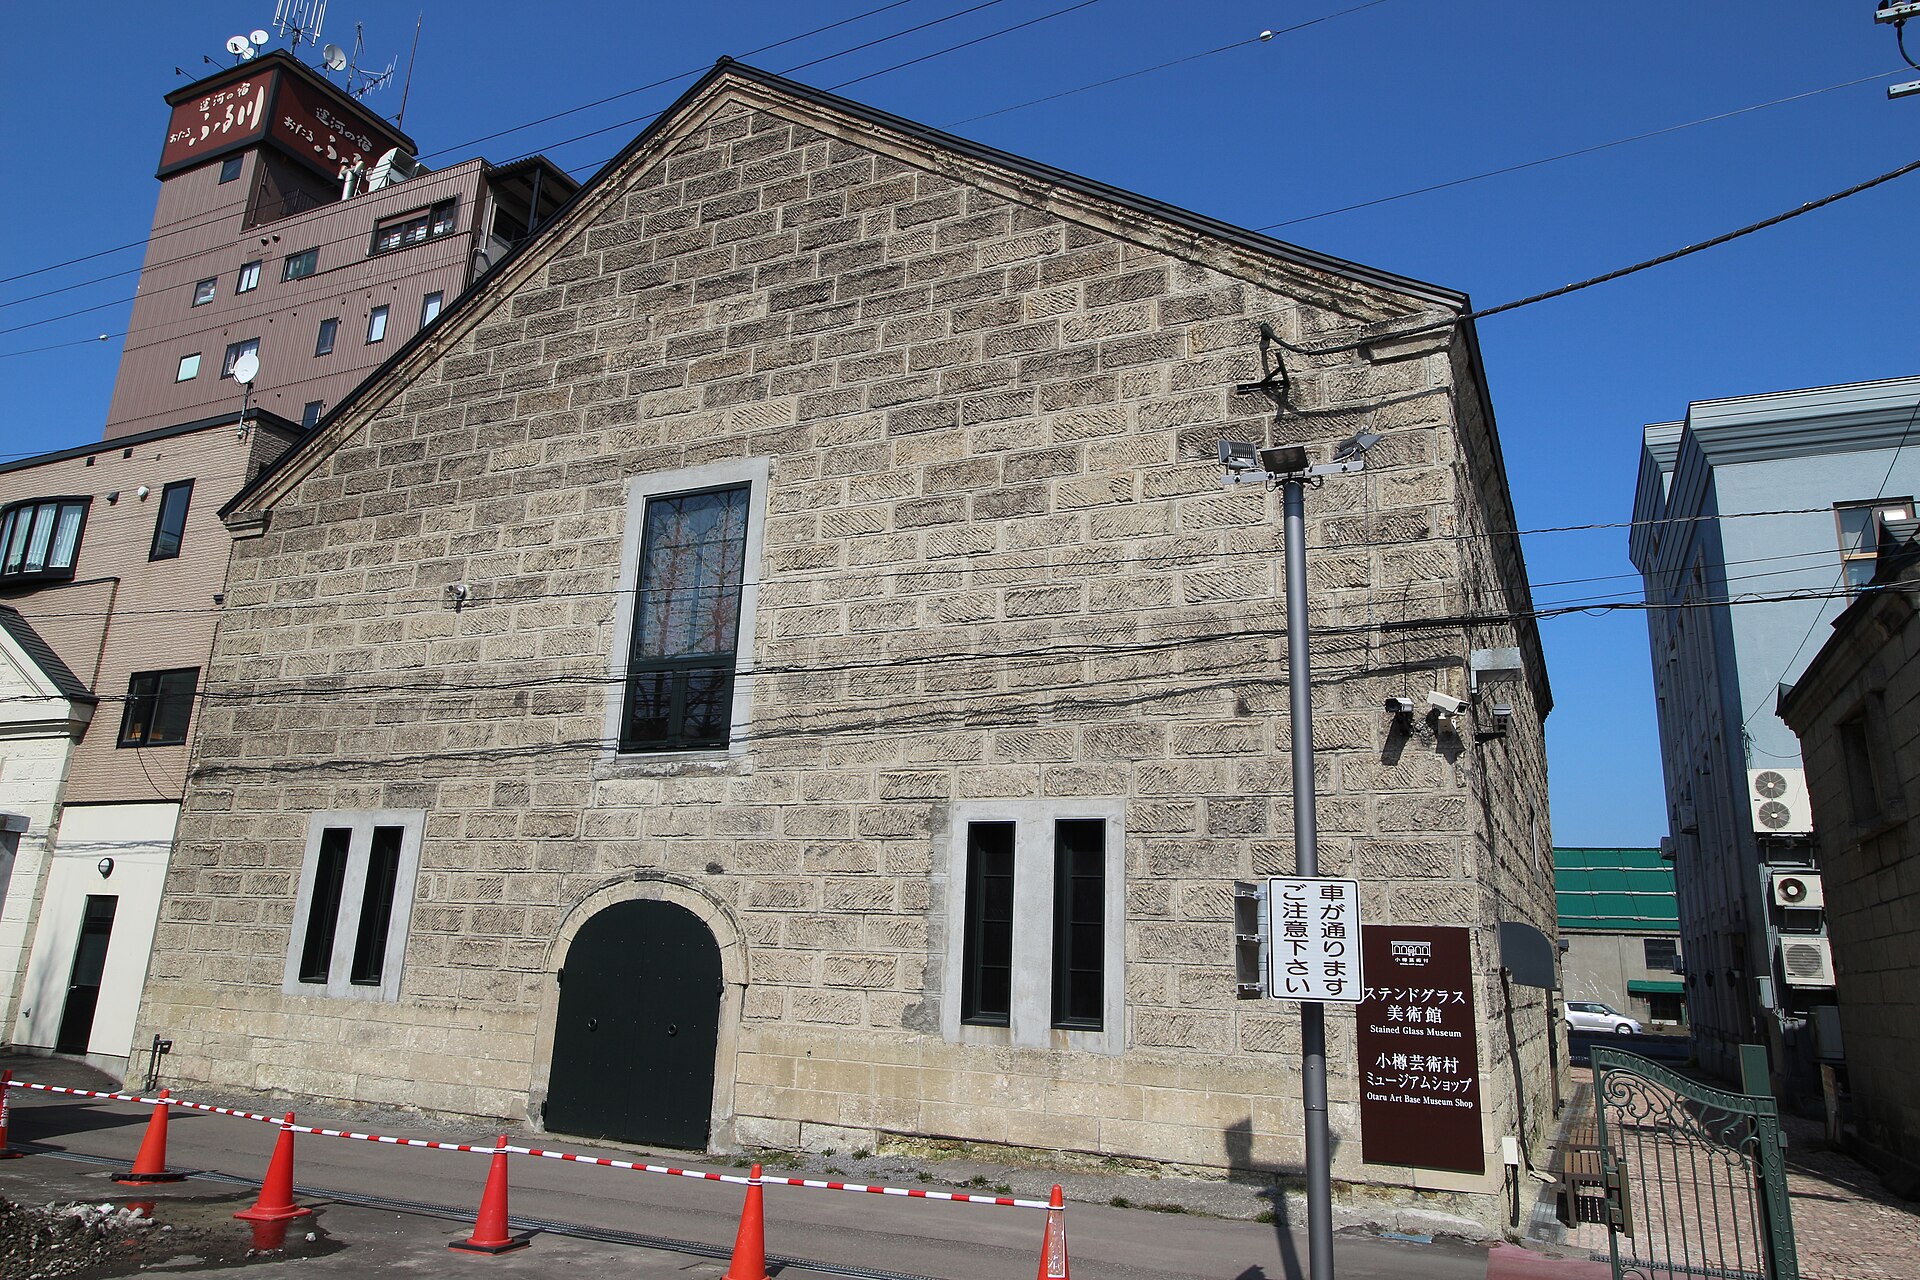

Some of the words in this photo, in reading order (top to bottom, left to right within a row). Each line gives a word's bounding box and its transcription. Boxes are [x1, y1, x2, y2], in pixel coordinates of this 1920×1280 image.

[200, 83, 251, 112] 運河の宿
[170, 127, 191, 143] おたる
[188, 86, 264, 147] ふる川
[283, 116, 314, 142] おたる
[315, 107, 373, 152] 運河の宿
[1282, 883, 1310, 993] ご注意下さい
[1319, 884, 1348, 996] 車が通ります
[1364, 987, 1466, 1005] ステンドグラス
[1387, 1004, 1442, 1024] 美術館
[1370, 1025, 1400, 1035] Stained
[1402, 1026, 1425, 1036] Glass
[1426, 1028, 1462, 1038] Museum
[1375, 1052, 1460, 1075] 小樽芸術村
[1366, 1071, 1473, 1094] ミュージアムショップ
[1366, 1091, 1388, 1101] Otaru
[1389, 1093, 1403, 1103] Art
[1404, 1094, 1421, 1104] Base
[1423, 1096, 1454, 1107] Museum
[1455, 1098, 1474, 1110] Shop
